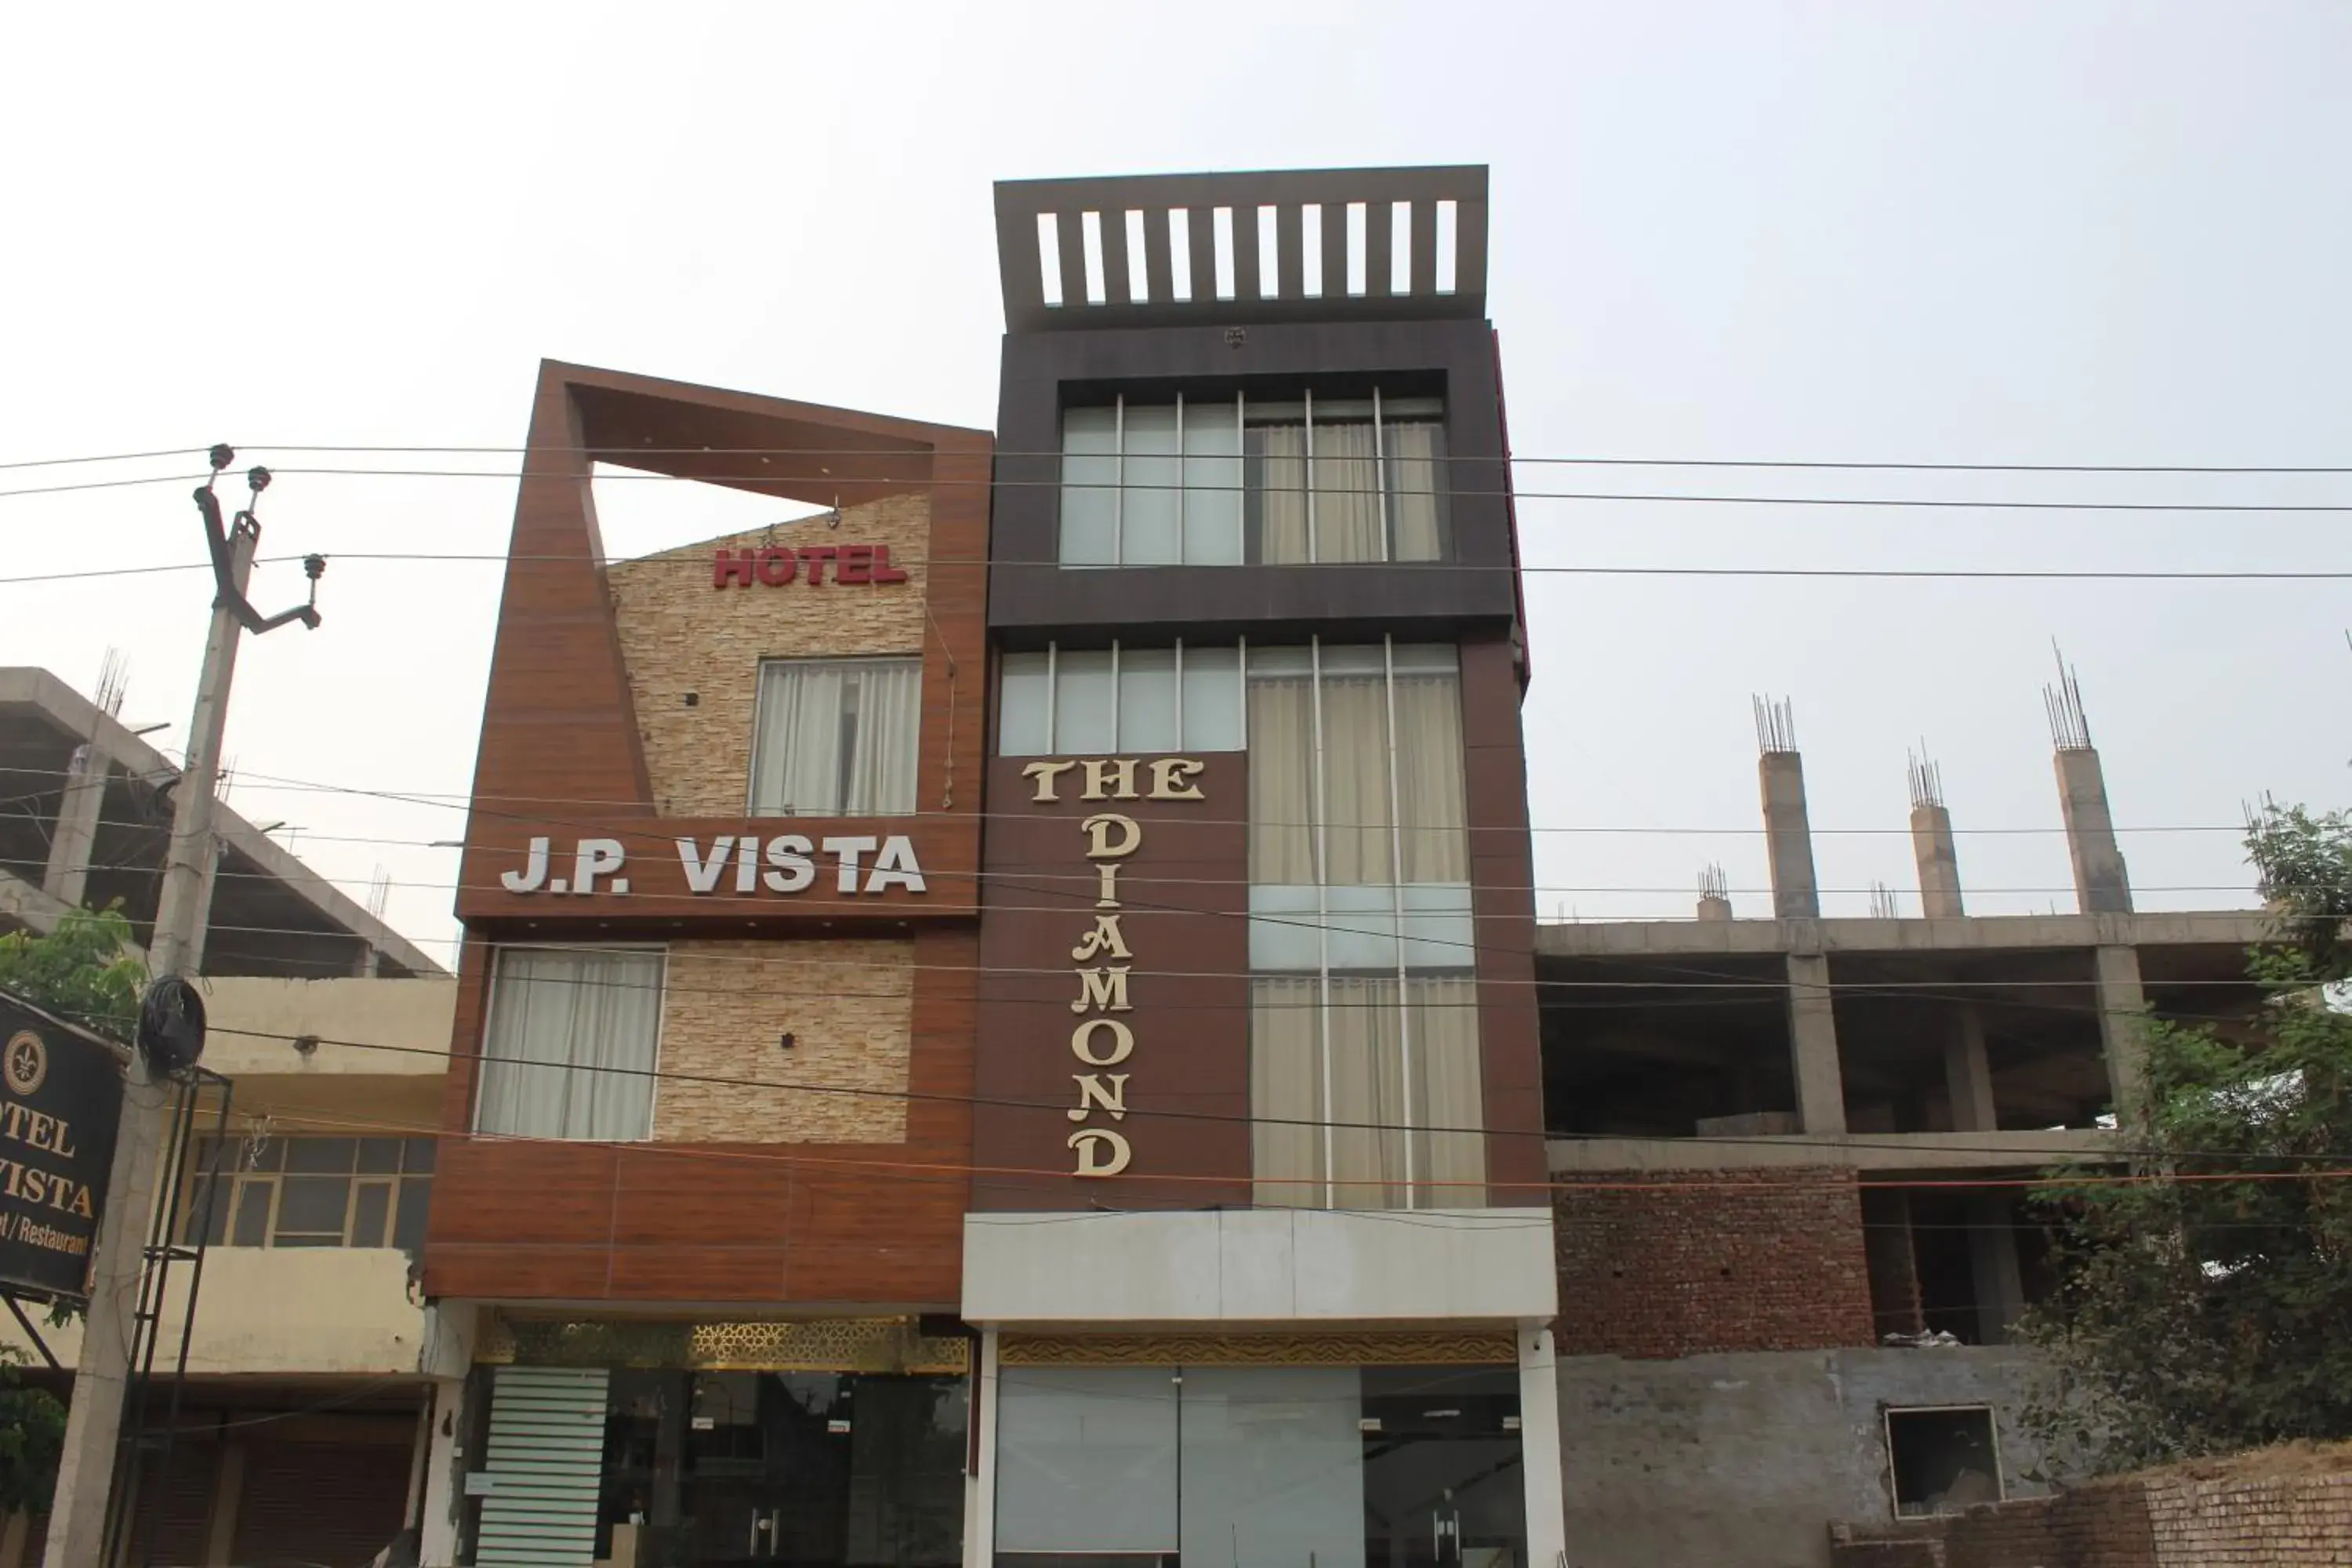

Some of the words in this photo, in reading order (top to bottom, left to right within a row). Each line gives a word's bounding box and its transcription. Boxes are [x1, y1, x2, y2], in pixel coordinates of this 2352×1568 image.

[715, 546, 908, 588] HOTEL
[1022, 760, 1204, 801] THE
[501, 837, 629, 895] J.P.
[675, 835, 927, 894] VISTA
[1068, 813, 1142, 1178] DIAMOND
[0, 1101, 75, 1158] TEL
